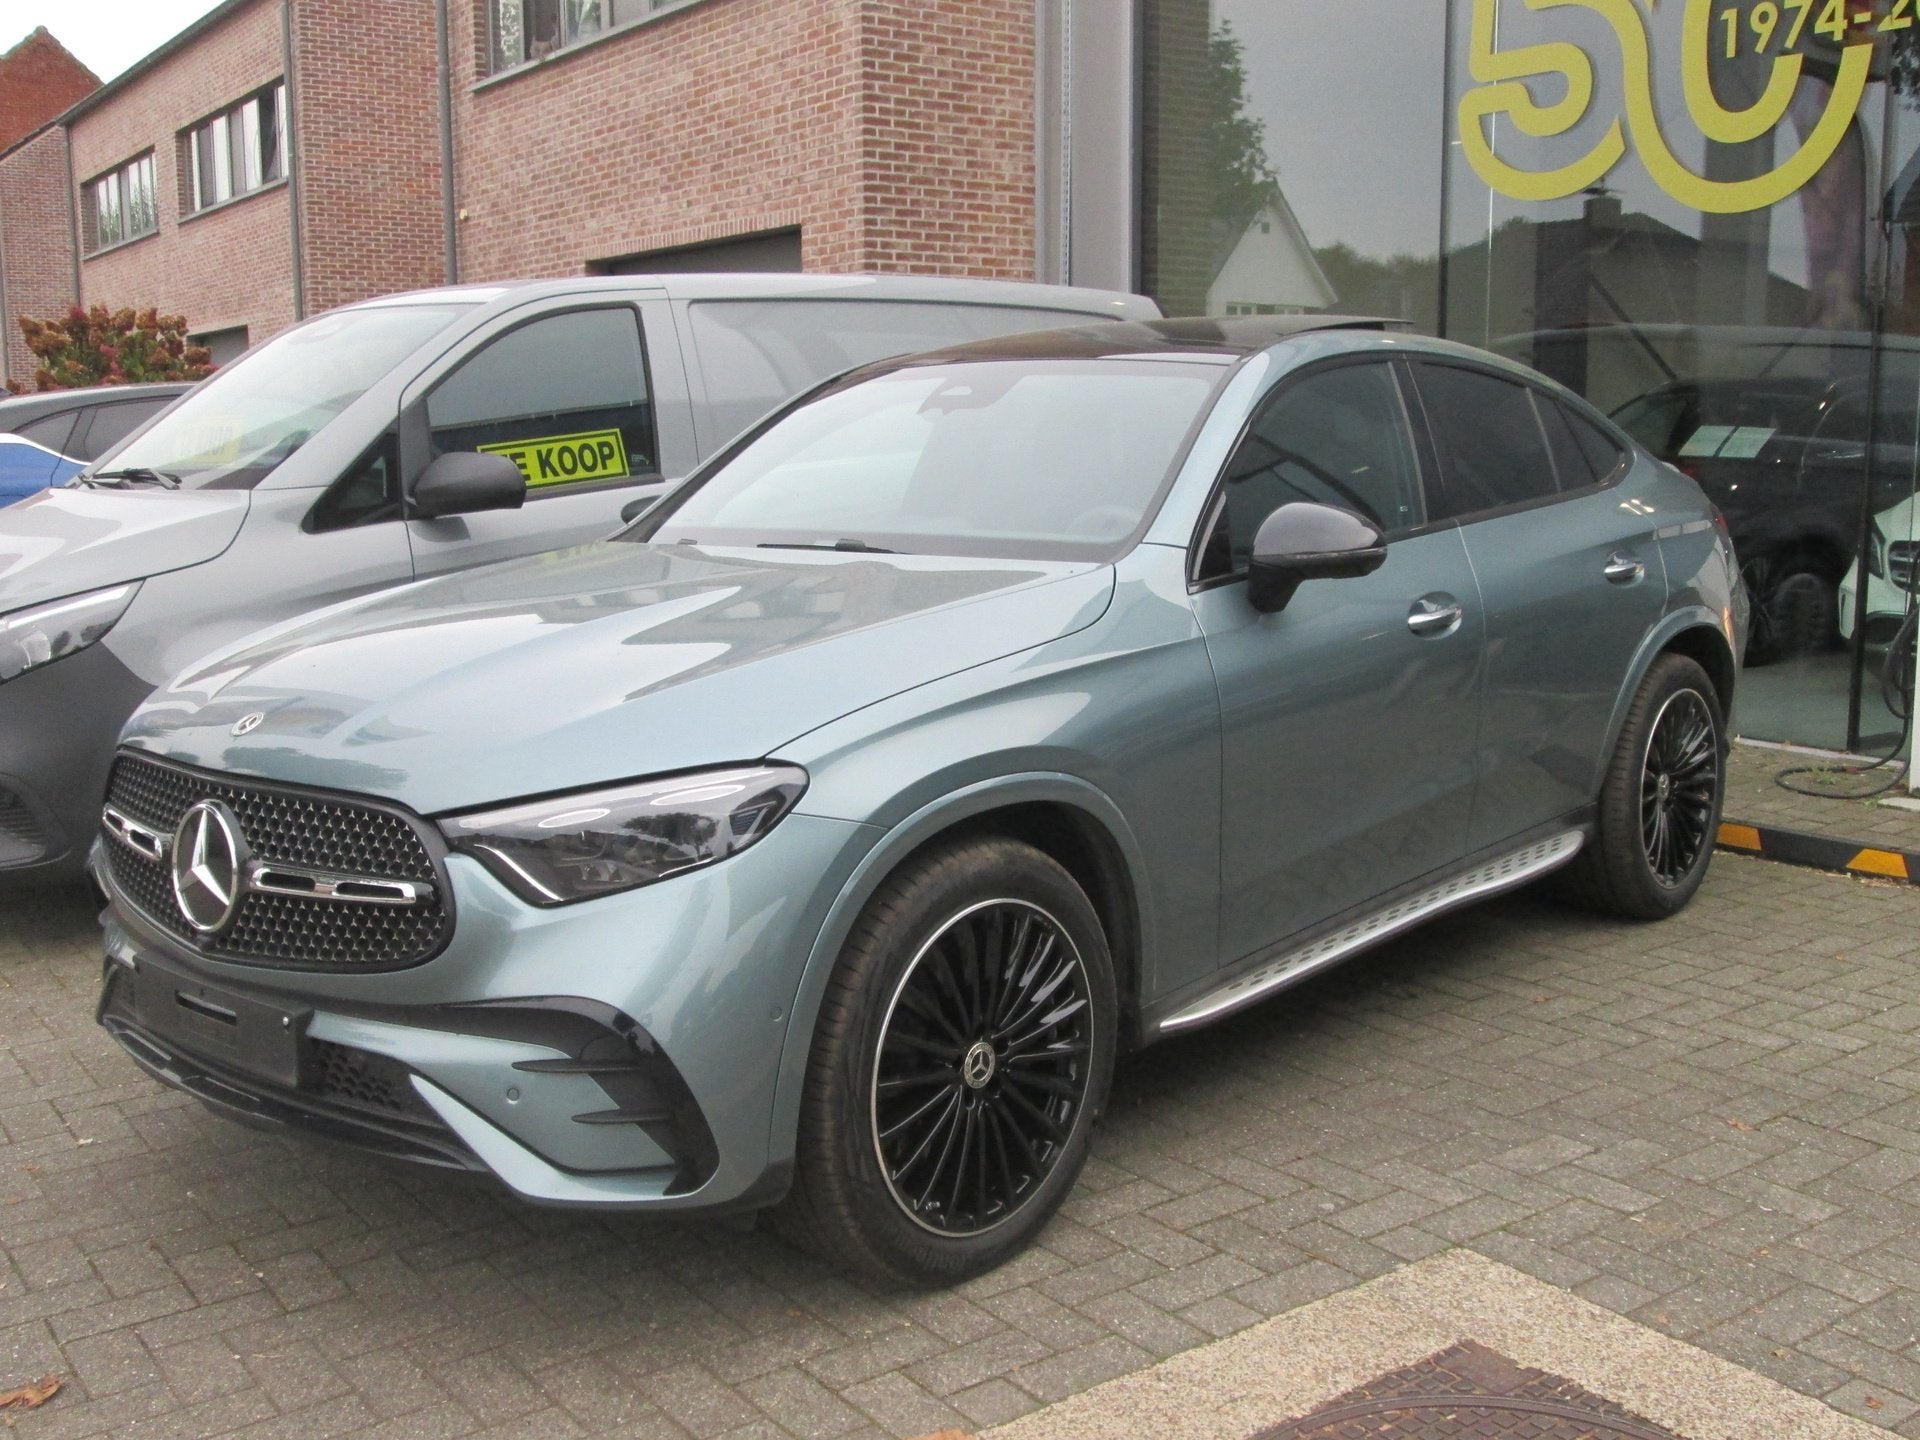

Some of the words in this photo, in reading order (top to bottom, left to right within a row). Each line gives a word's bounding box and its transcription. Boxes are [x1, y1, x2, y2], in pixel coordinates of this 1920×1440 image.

[1720, 0, 1920, 59] 1974-2
[502, 452, 532, 481] E
[536, 441, 615, 479] KOOP
